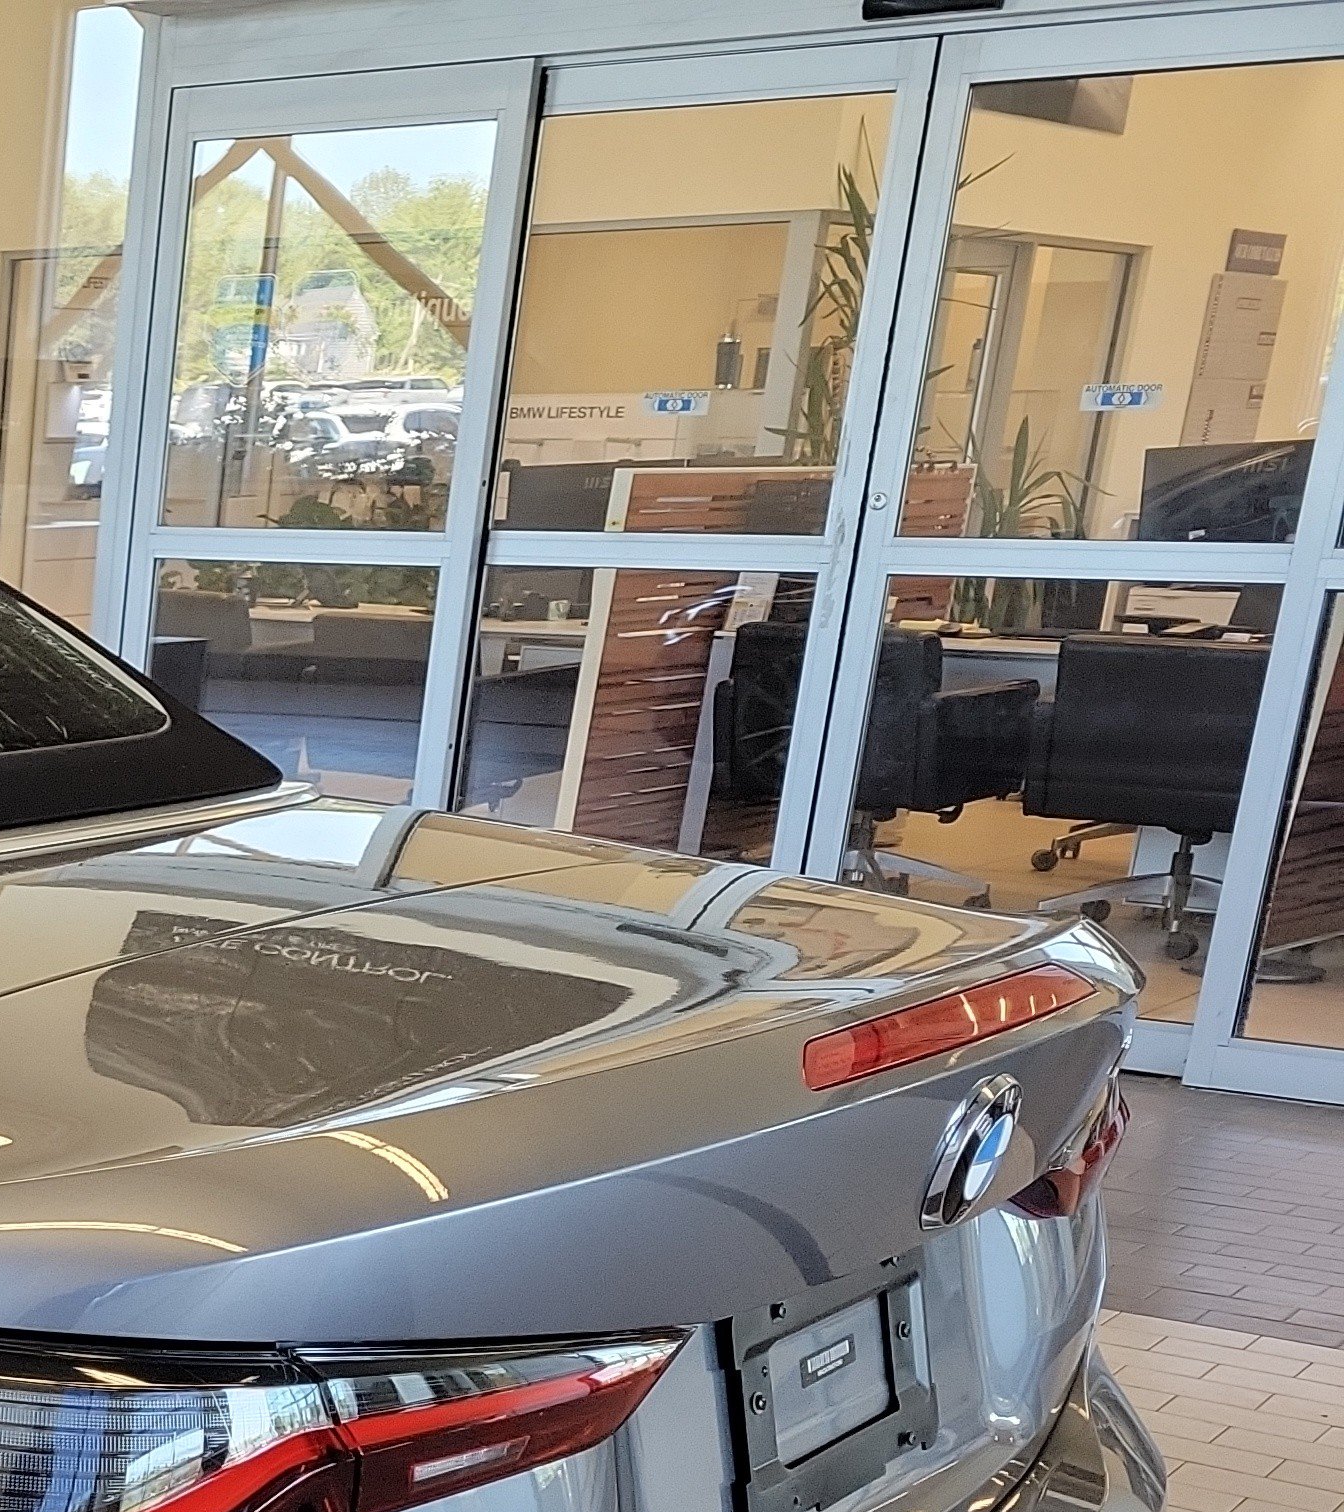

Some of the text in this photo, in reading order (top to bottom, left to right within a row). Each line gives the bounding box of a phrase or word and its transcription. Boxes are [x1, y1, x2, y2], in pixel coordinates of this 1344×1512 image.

[1085, 383, 1163, 393] AUTOMATIC DOOR
[644, 391, 710, 400] AUTOMATIC DOOR
[510, 406, 626, 420] BMW LIFESTYLE
